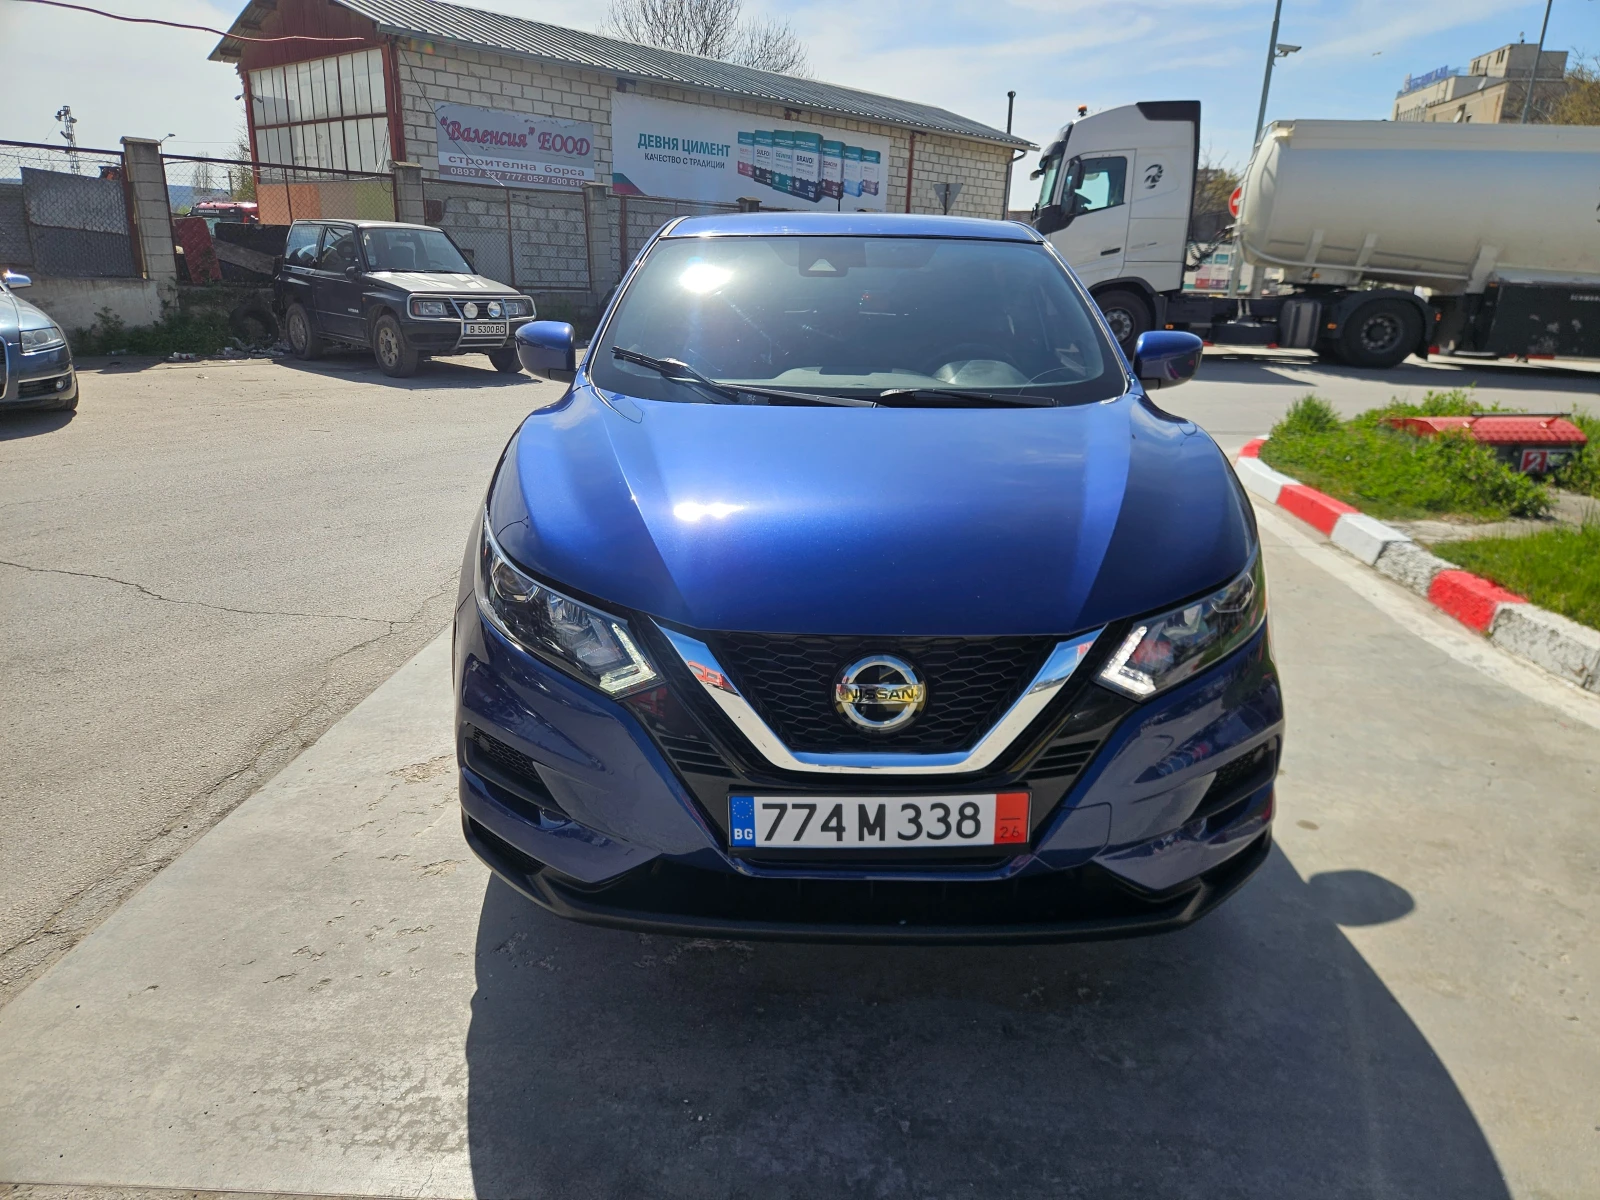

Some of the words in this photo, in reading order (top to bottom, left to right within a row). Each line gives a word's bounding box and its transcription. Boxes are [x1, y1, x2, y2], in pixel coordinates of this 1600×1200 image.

[637, 132, 679, 151] ДЕВНЯ
[682, 138, 731, 157] ЦИМЕНТ
[448, 155, 537, 172] строителна
[544, 164, 585, 177] борса
[644, 152, 681, 165] КАЧЕСТВО
[682, 157, 688, 165] С
[689, 157, 725, 169] ТРАДИЦИИ
[450, 167, 476, 176] 0893
[527, 174, 544, 183] 052
[551, 177, 567, 185] 500
[846, 688, 914, 700] NISSAN
[762, 802, 846, 842] 774
[857, 803, 886, 842] M
[896, 801, 982, 841] 338
[733, 827, 753, 840] BG
[999, 825, 1020, 839] 26
